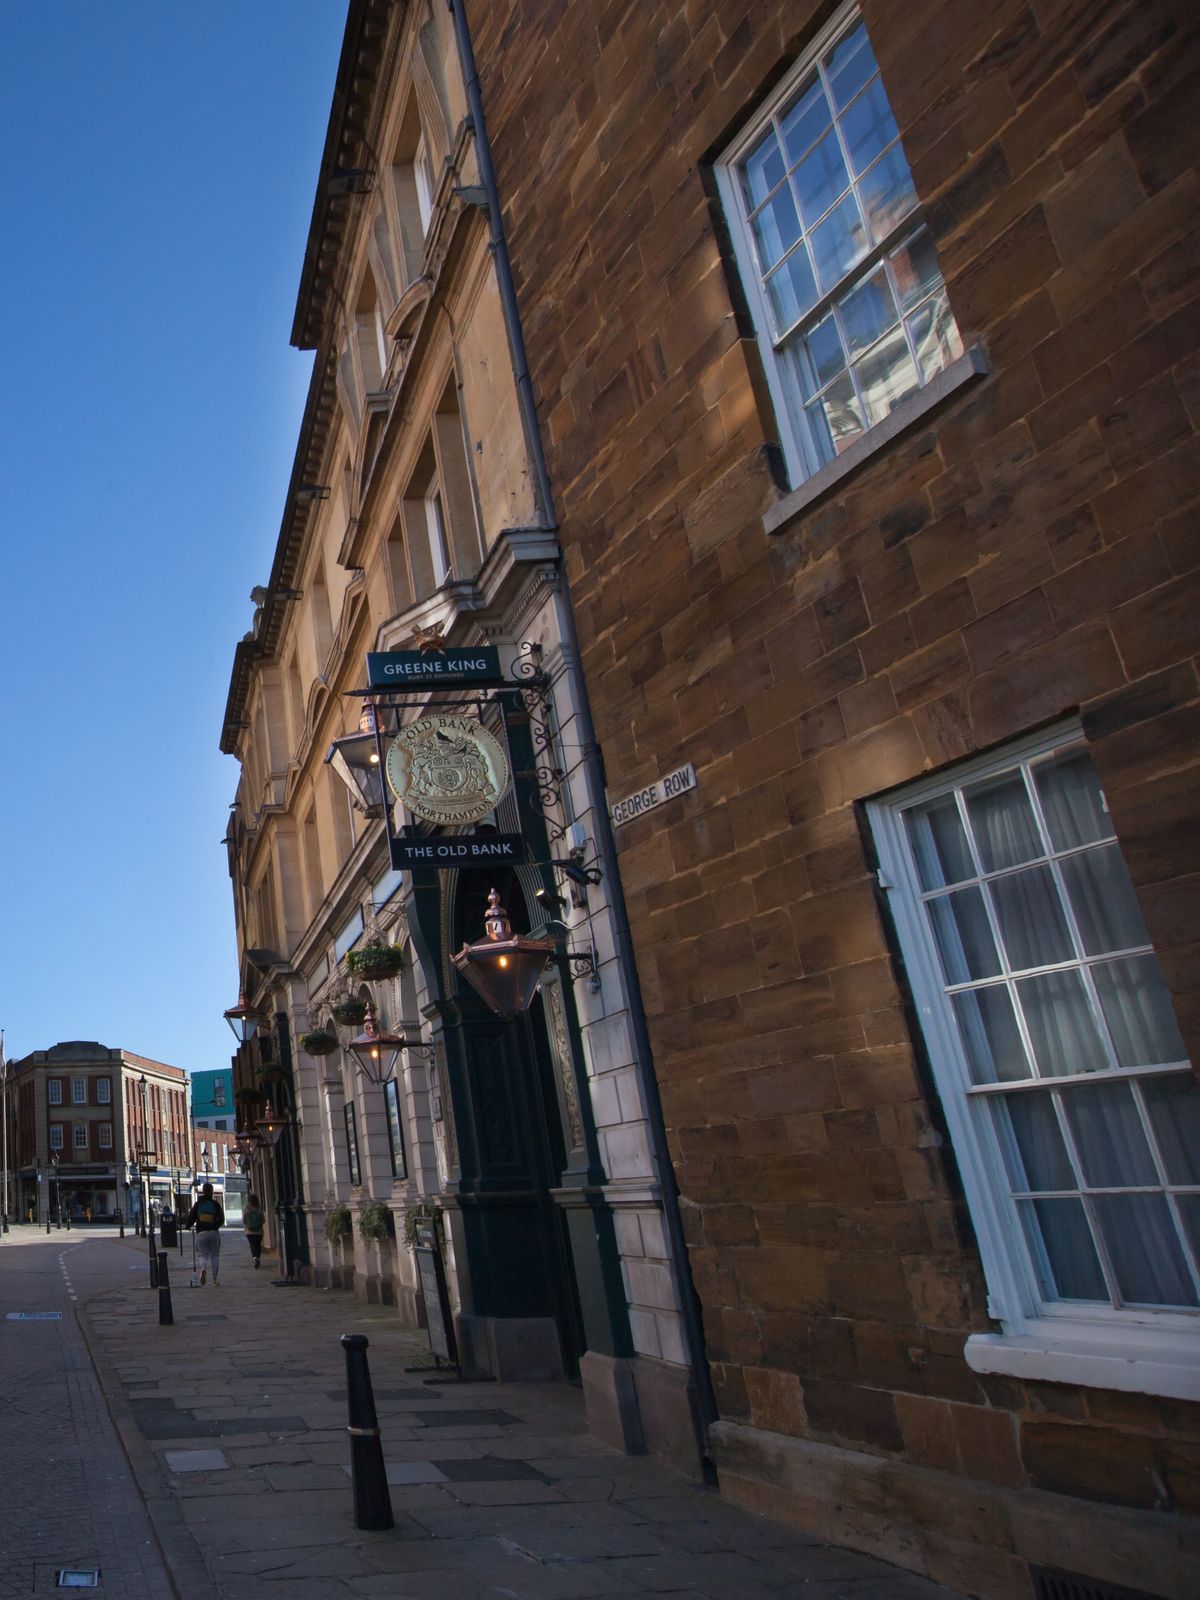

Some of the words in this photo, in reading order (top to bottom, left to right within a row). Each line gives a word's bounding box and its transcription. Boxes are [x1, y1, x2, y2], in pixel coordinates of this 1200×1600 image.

[384, 661, 443, 675] GREENE
[448, 659, 487, 671] KING
[406, 720, 433, 740] OLD
[438, 717, 476, 736] BANK
[614, 786, 658, 822] GEORGE
[663, 767, 691, 797] ROW
[414, 800, 493, 821] NORTHAMPTON
[404, 846, 434, 858] THE
[437, 845, 468, 857] OLD
[471, 843, 513, 855] BANK
